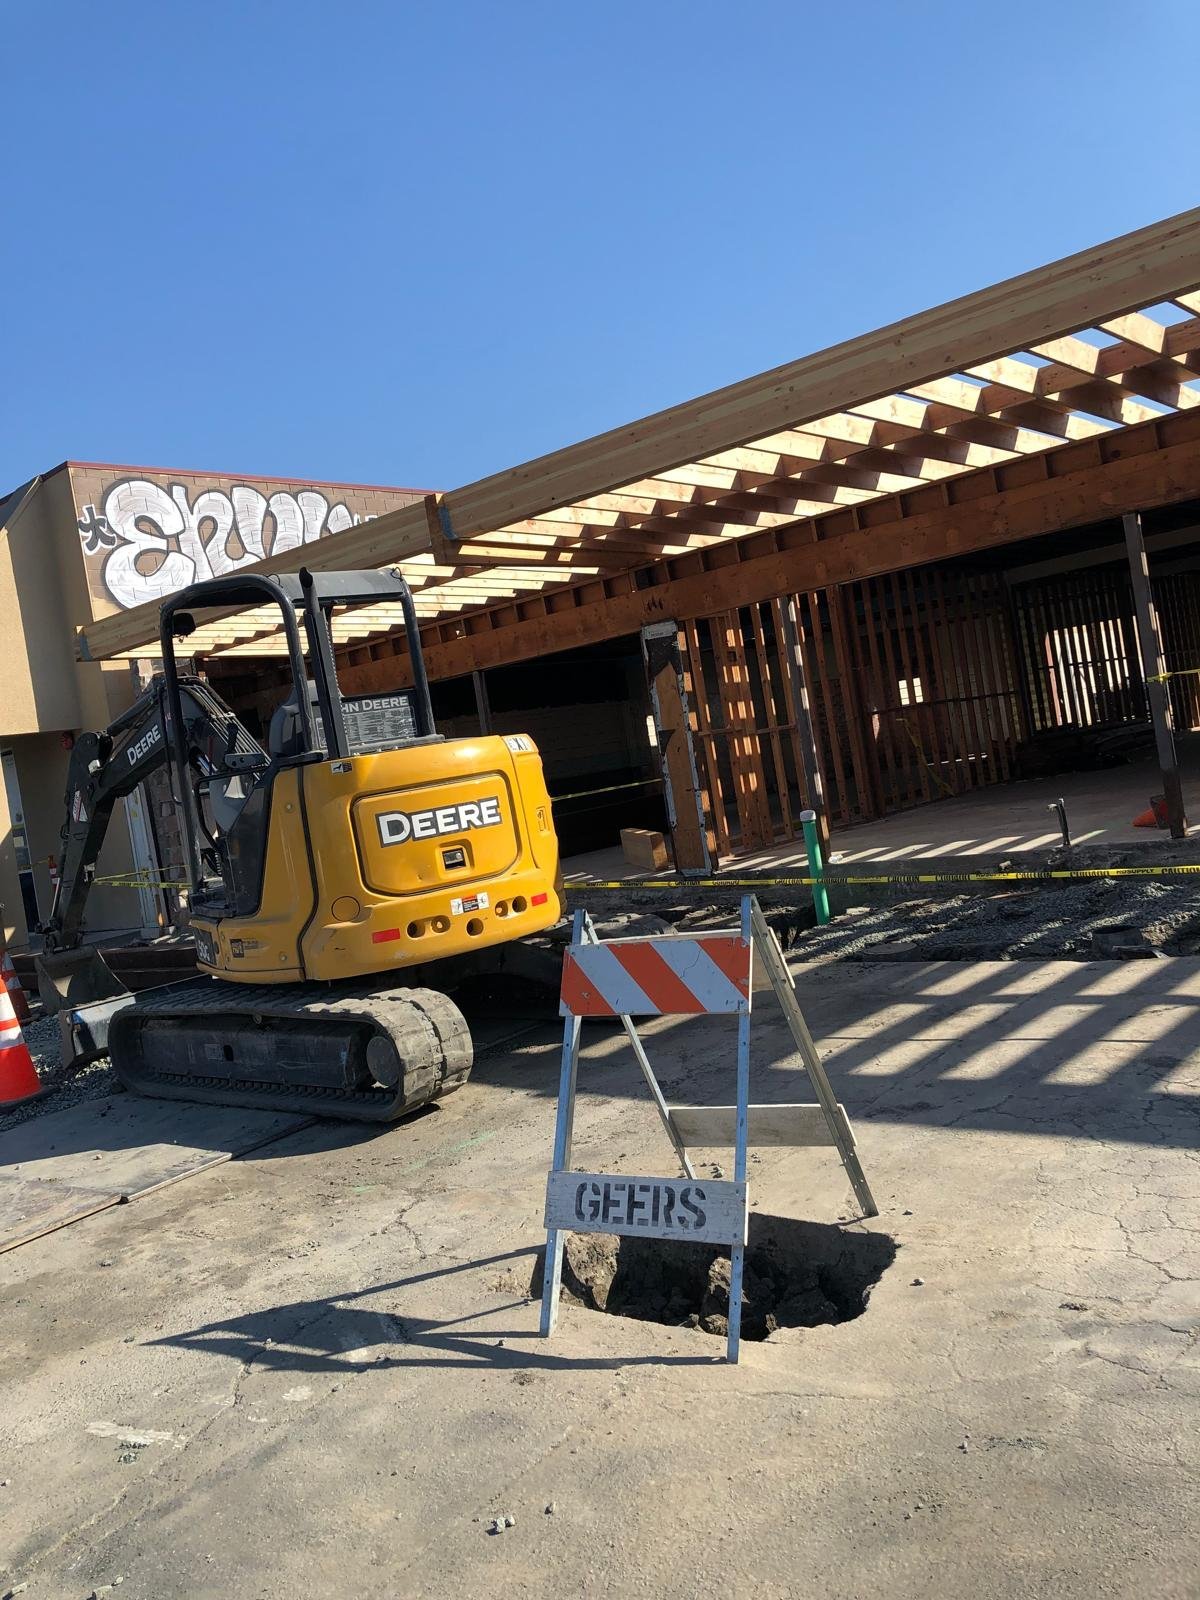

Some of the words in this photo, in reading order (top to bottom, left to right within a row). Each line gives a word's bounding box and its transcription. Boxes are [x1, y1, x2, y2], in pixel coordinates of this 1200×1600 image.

[362, 697, 409, 711] DEERE
[127, 724, 161, 766] DEERE
[378, 798, 501, 845] DEERE
[575, 1182, 707, 1230] GEERS
